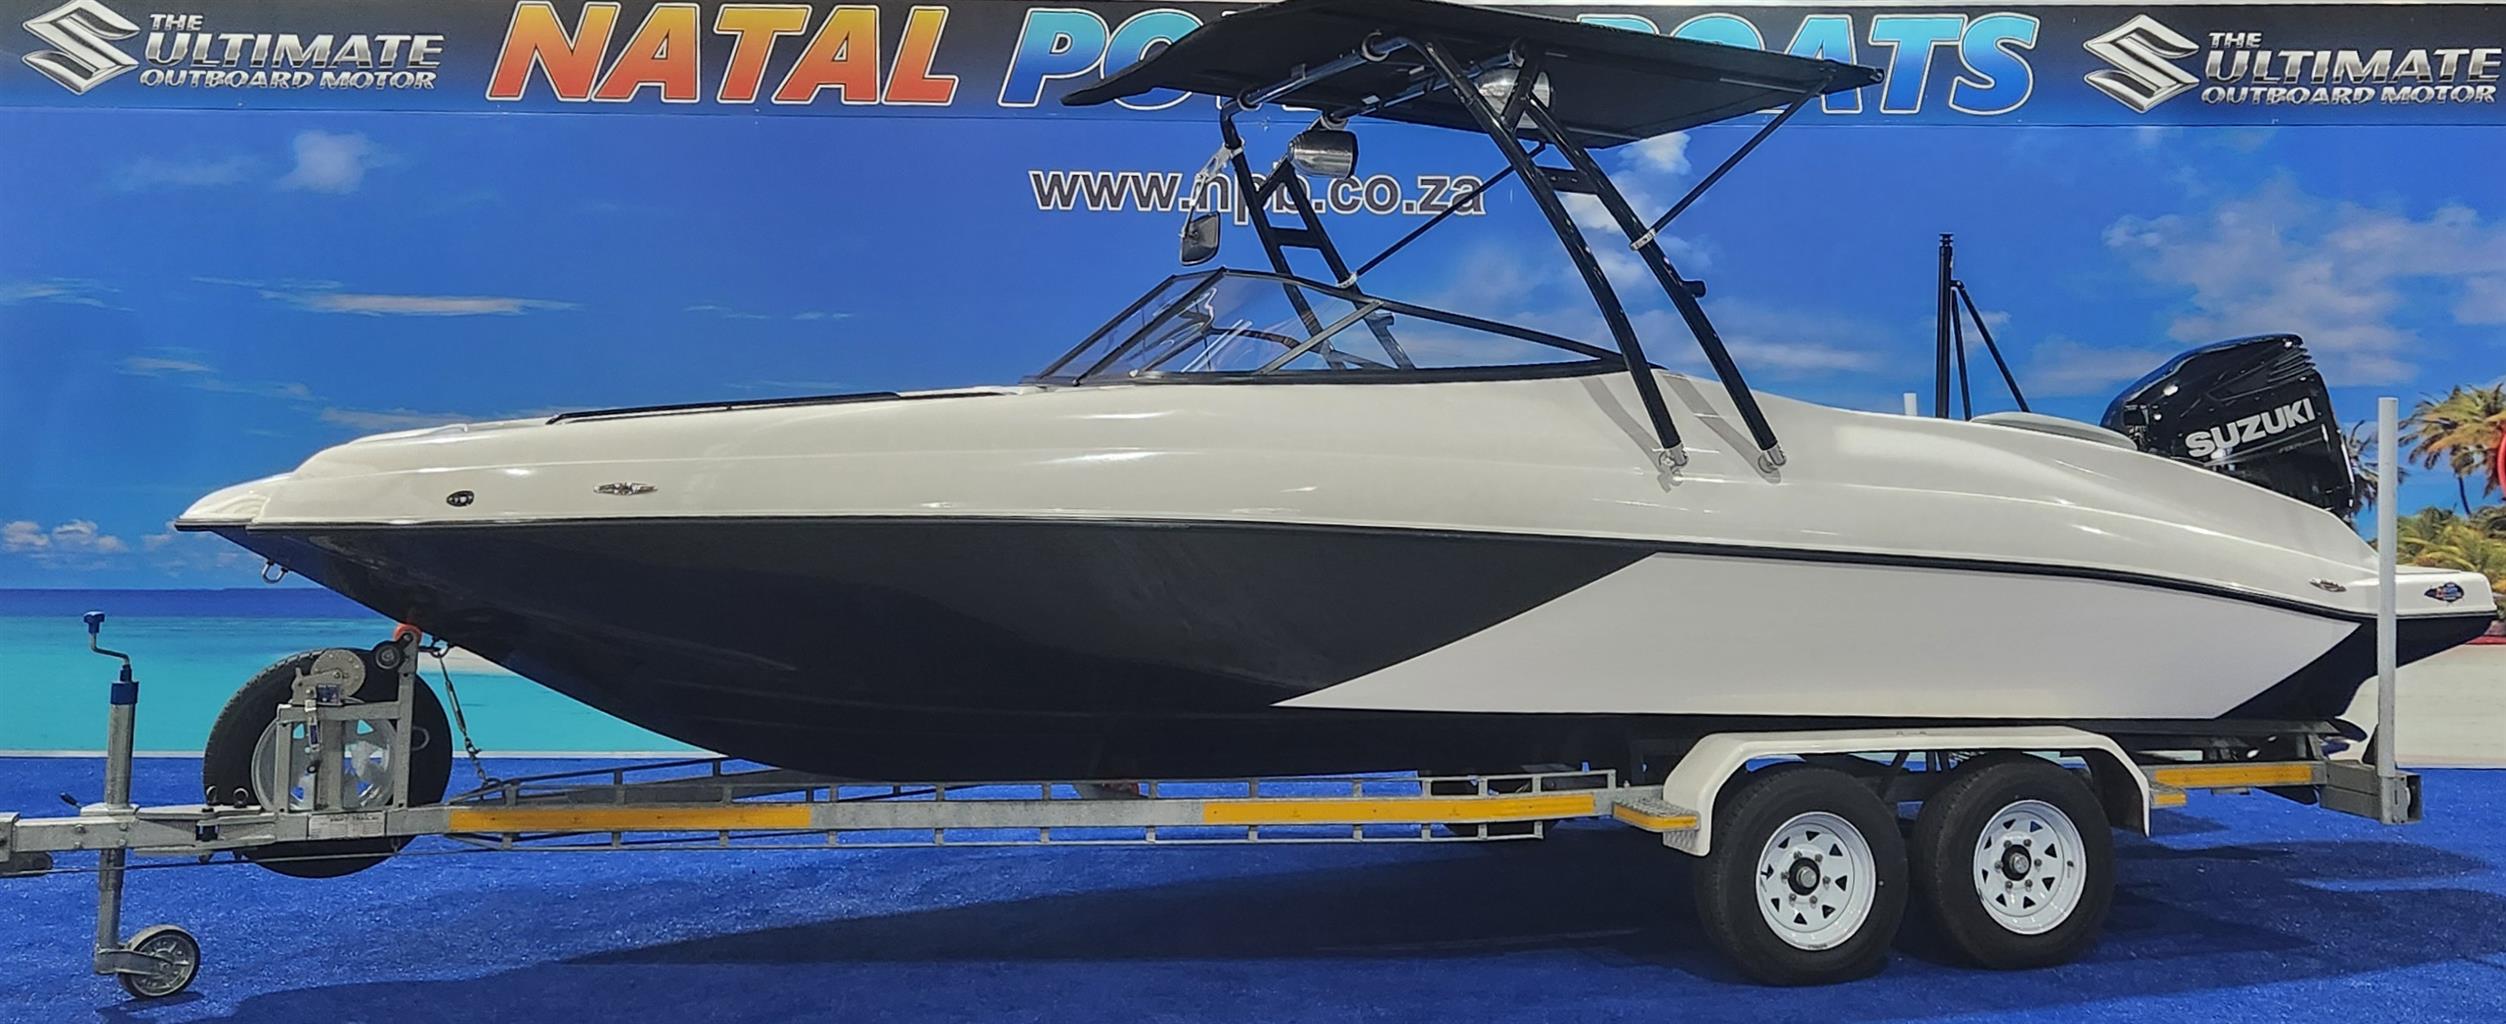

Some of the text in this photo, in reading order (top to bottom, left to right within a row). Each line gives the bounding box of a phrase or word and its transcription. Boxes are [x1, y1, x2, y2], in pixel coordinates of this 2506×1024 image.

[150, 13, 203, 31] THE
[142, 33, 445, 69] ULTIMATE
[486, 3, 960, 104] NATAL
[2208, 32, 2262, 49] THE
[139, 68, 437, 90] OUTBOARD MOTOR
[1576, 12, 2039, 116] ATS
[2204, 47, 2502, 84] ULTIMATE
[2201, 84, 2497, 105] OUTBOARD MOTOR
[2184, 397, 2316, 458] SUZUKI
